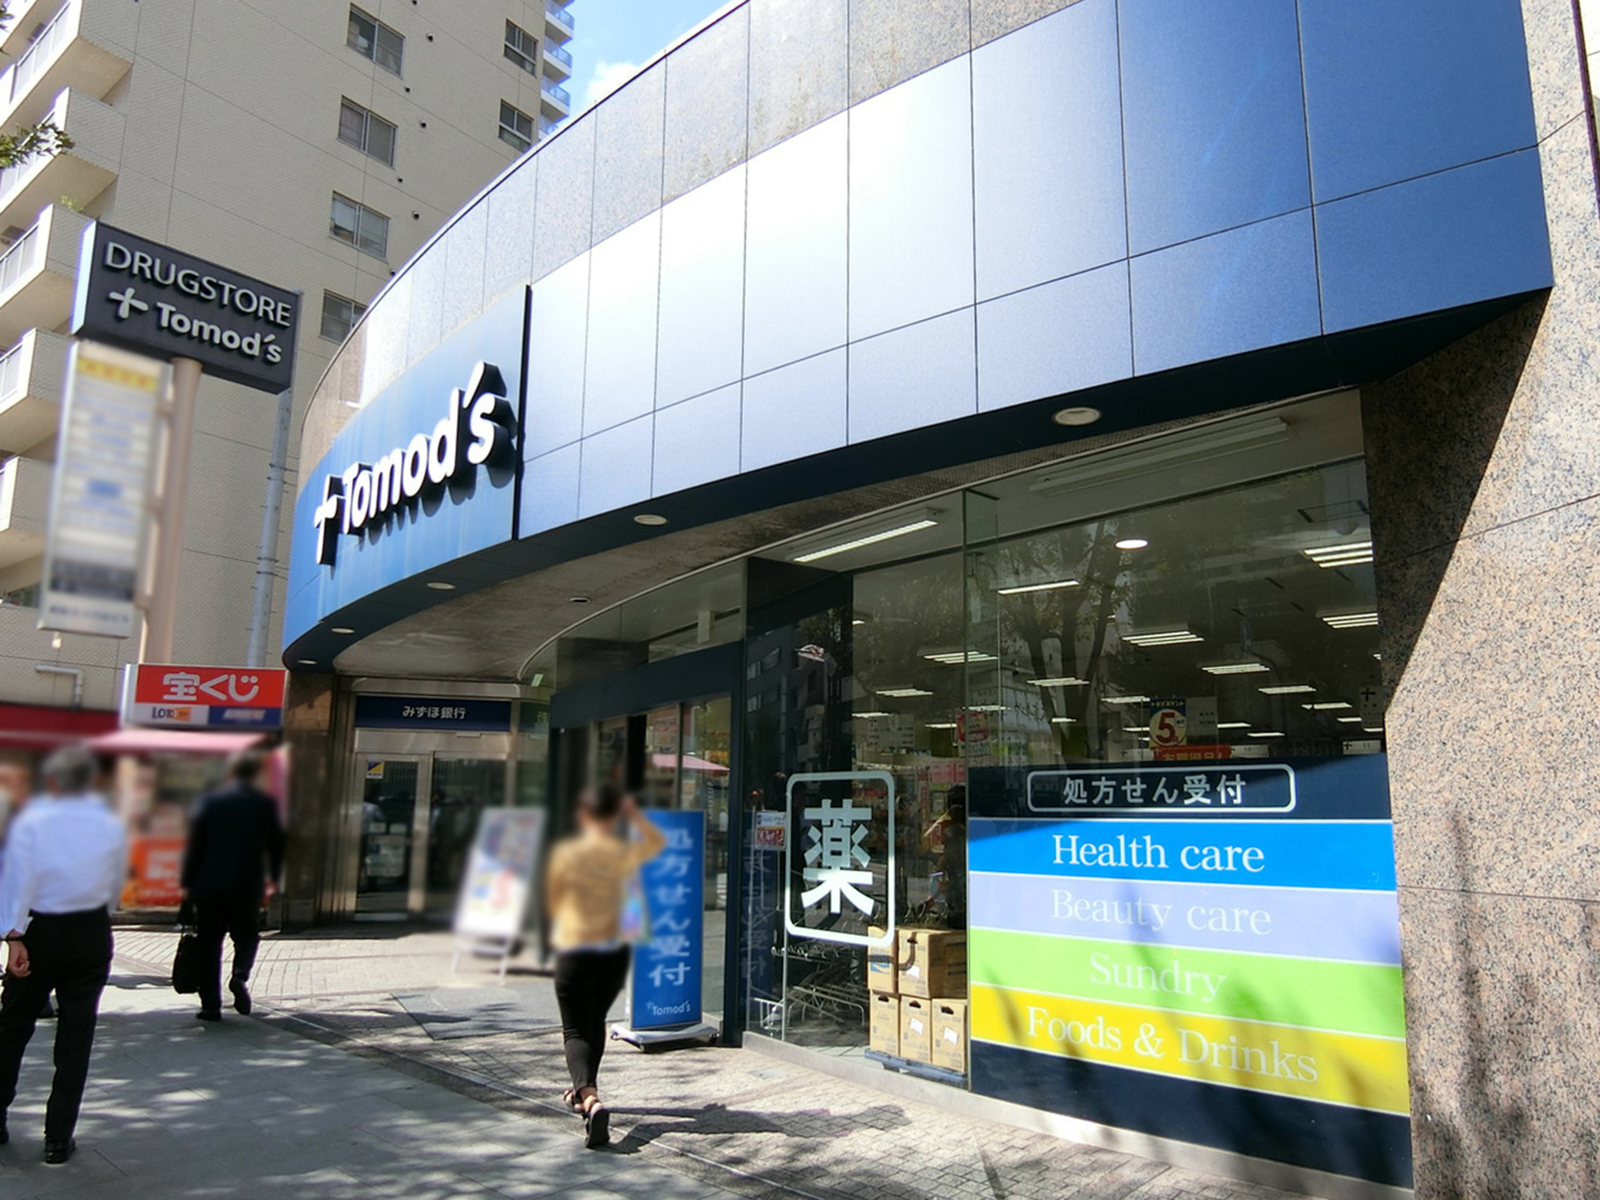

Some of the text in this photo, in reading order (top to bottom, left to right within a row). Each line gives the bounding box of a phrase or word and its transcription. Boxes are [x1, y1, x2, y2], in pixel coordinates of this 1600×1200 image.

[104, 241, 293, 328] DRUGSTORE
[156, 301, 283, 364] Tomod's
[342, 360, 497, 536] Tomod's
[163, 671, 260, 702] 宝くじ
[402, 705, 467, 720] みずほ銀行
[1063, 774, 1247, 806] 処方せん受付
[801, 799, 875, 916] 薬
[1052, 834, 1266, 873] Health care
[1051, 889, 1272, 935] Beauty care
[1090, 953, 1227, 1002] Sundry
[652, 1000, 691, 1016] Tomod's
[1027, 1006, 1318, 1082] Foods & Drinks
